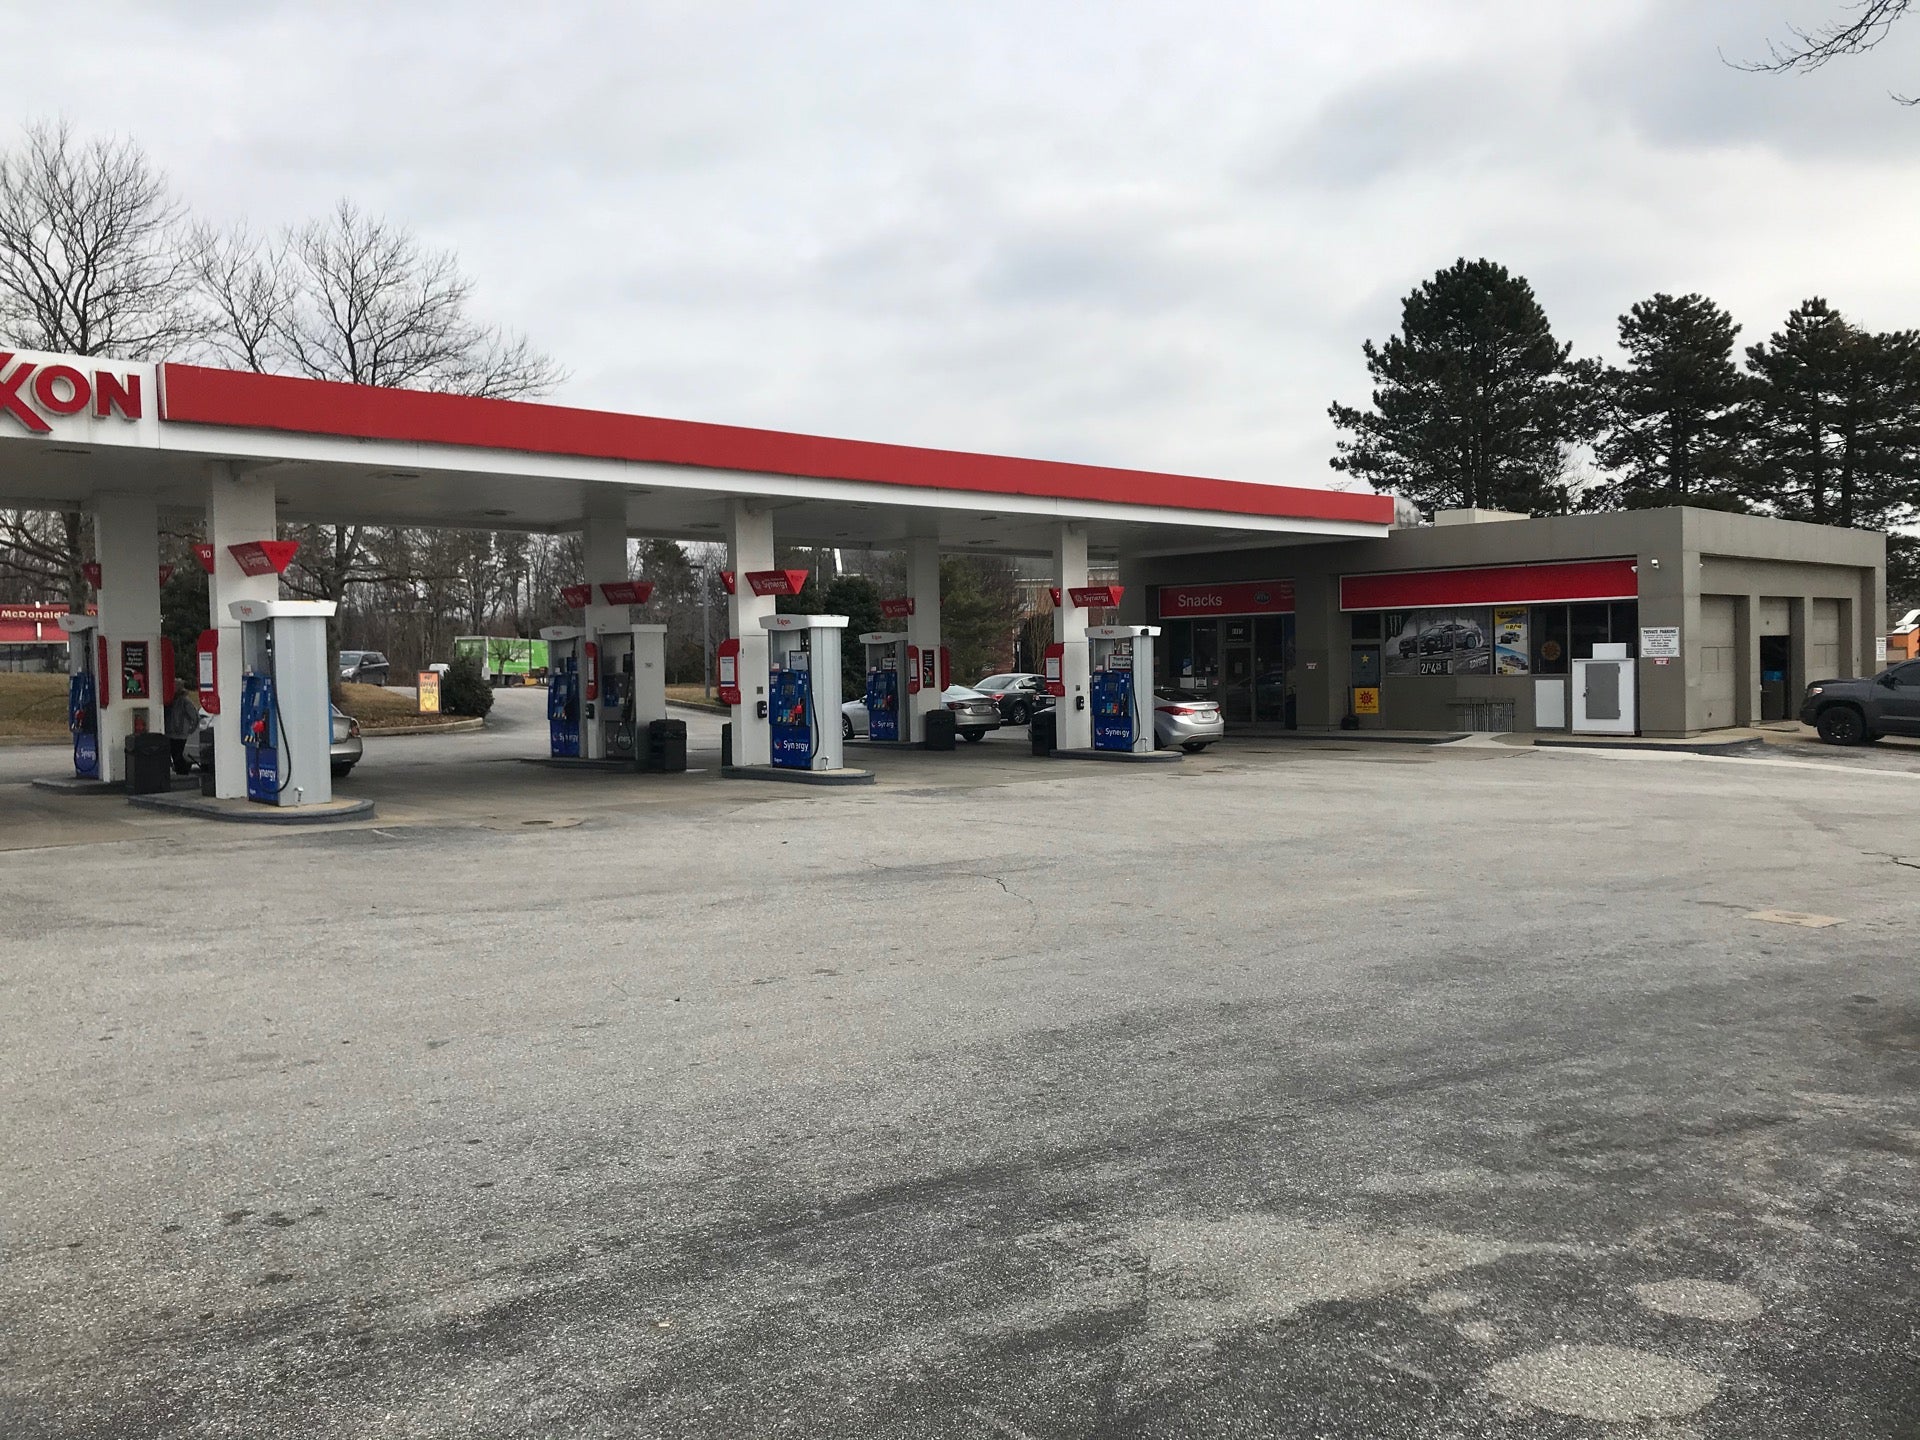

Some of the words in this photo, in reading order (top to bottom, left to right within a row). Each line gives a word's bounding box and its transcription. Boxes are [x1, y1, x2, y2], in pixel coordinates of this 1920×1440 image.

[201, 549, 211, 559] 10
[728, 575, 734, 584] 6
[761, 580, 788, 590] Synergy
[1055, 591, 1060, 599] 2
[1083, 594, 1109, 603] Synergy
[1178, 594, 1222, 607] Snacks
[1105, 727, 1130, 737] Synergy
[258, 768, 276, 782] ynergy
